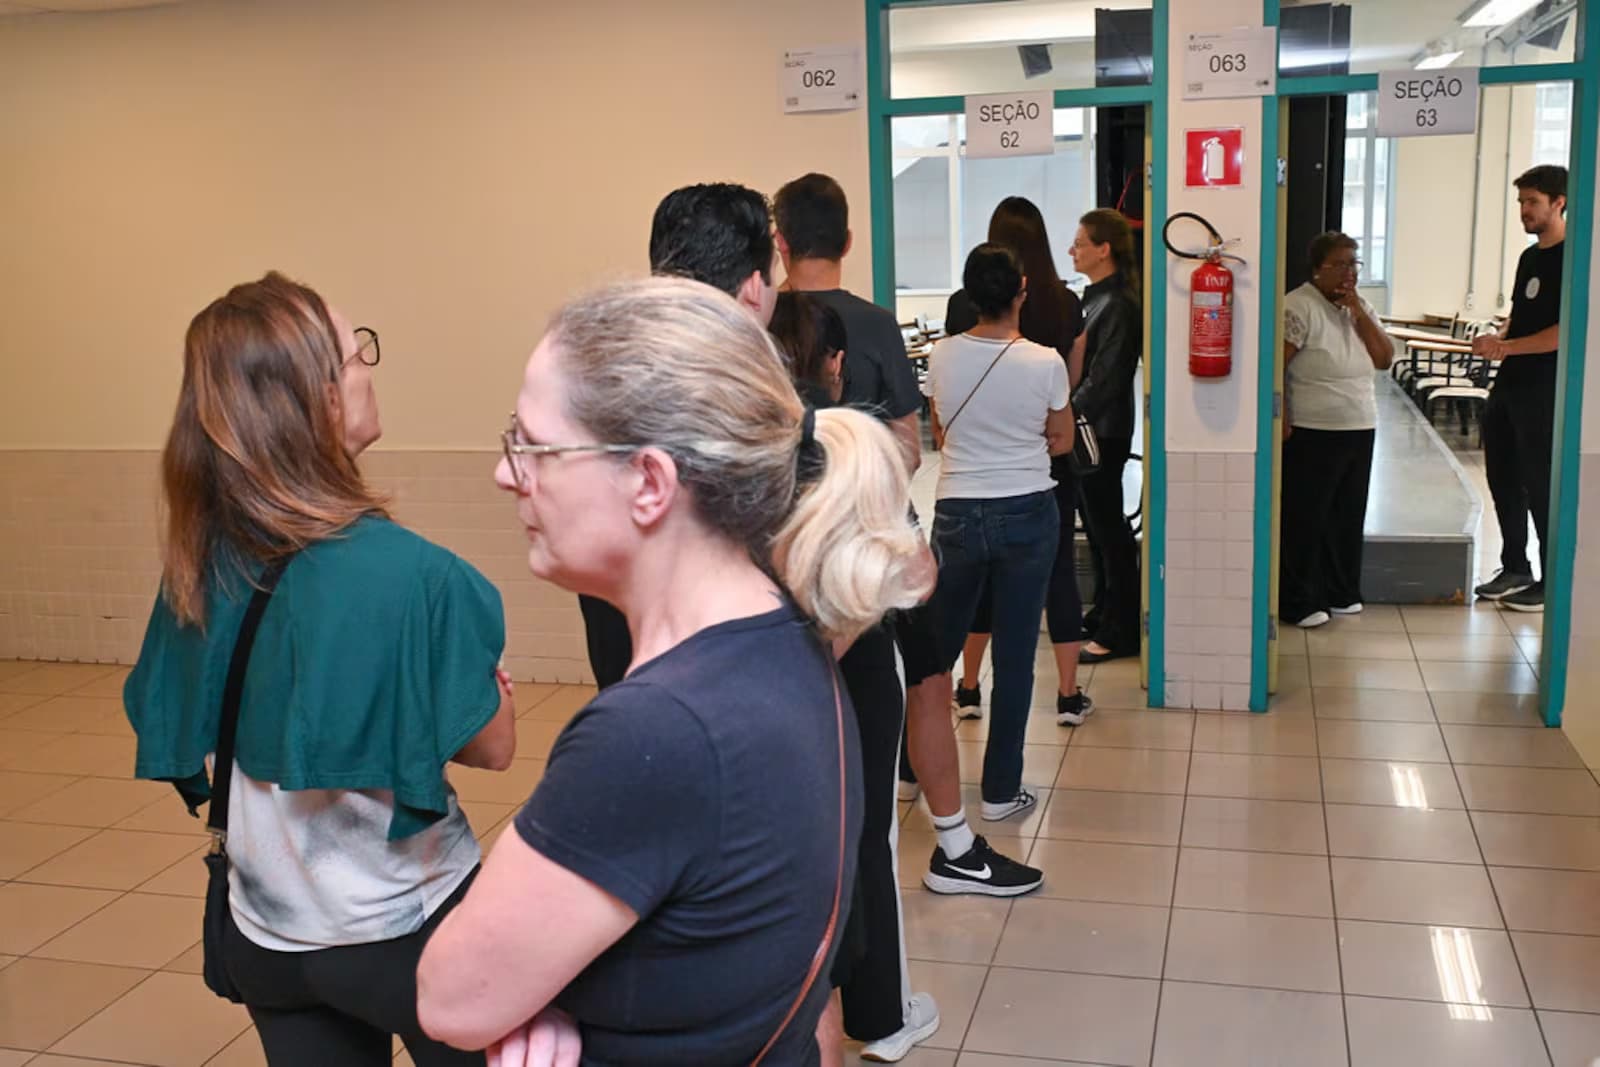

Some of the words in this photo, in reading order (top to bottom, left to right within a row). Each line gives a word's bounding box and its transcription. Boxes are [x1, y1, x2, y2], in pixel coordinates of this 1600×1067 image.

[1209, 53, 1246, 73] 063
[803, 69, 836, 88] 062
[1394, 76, 1462, 102] SEÇÃO
[980, 100, 1039, 125] SEÇÃO
[1416, 108, 1438, 127] 63
[1000, 131, 1019, 148] 62
